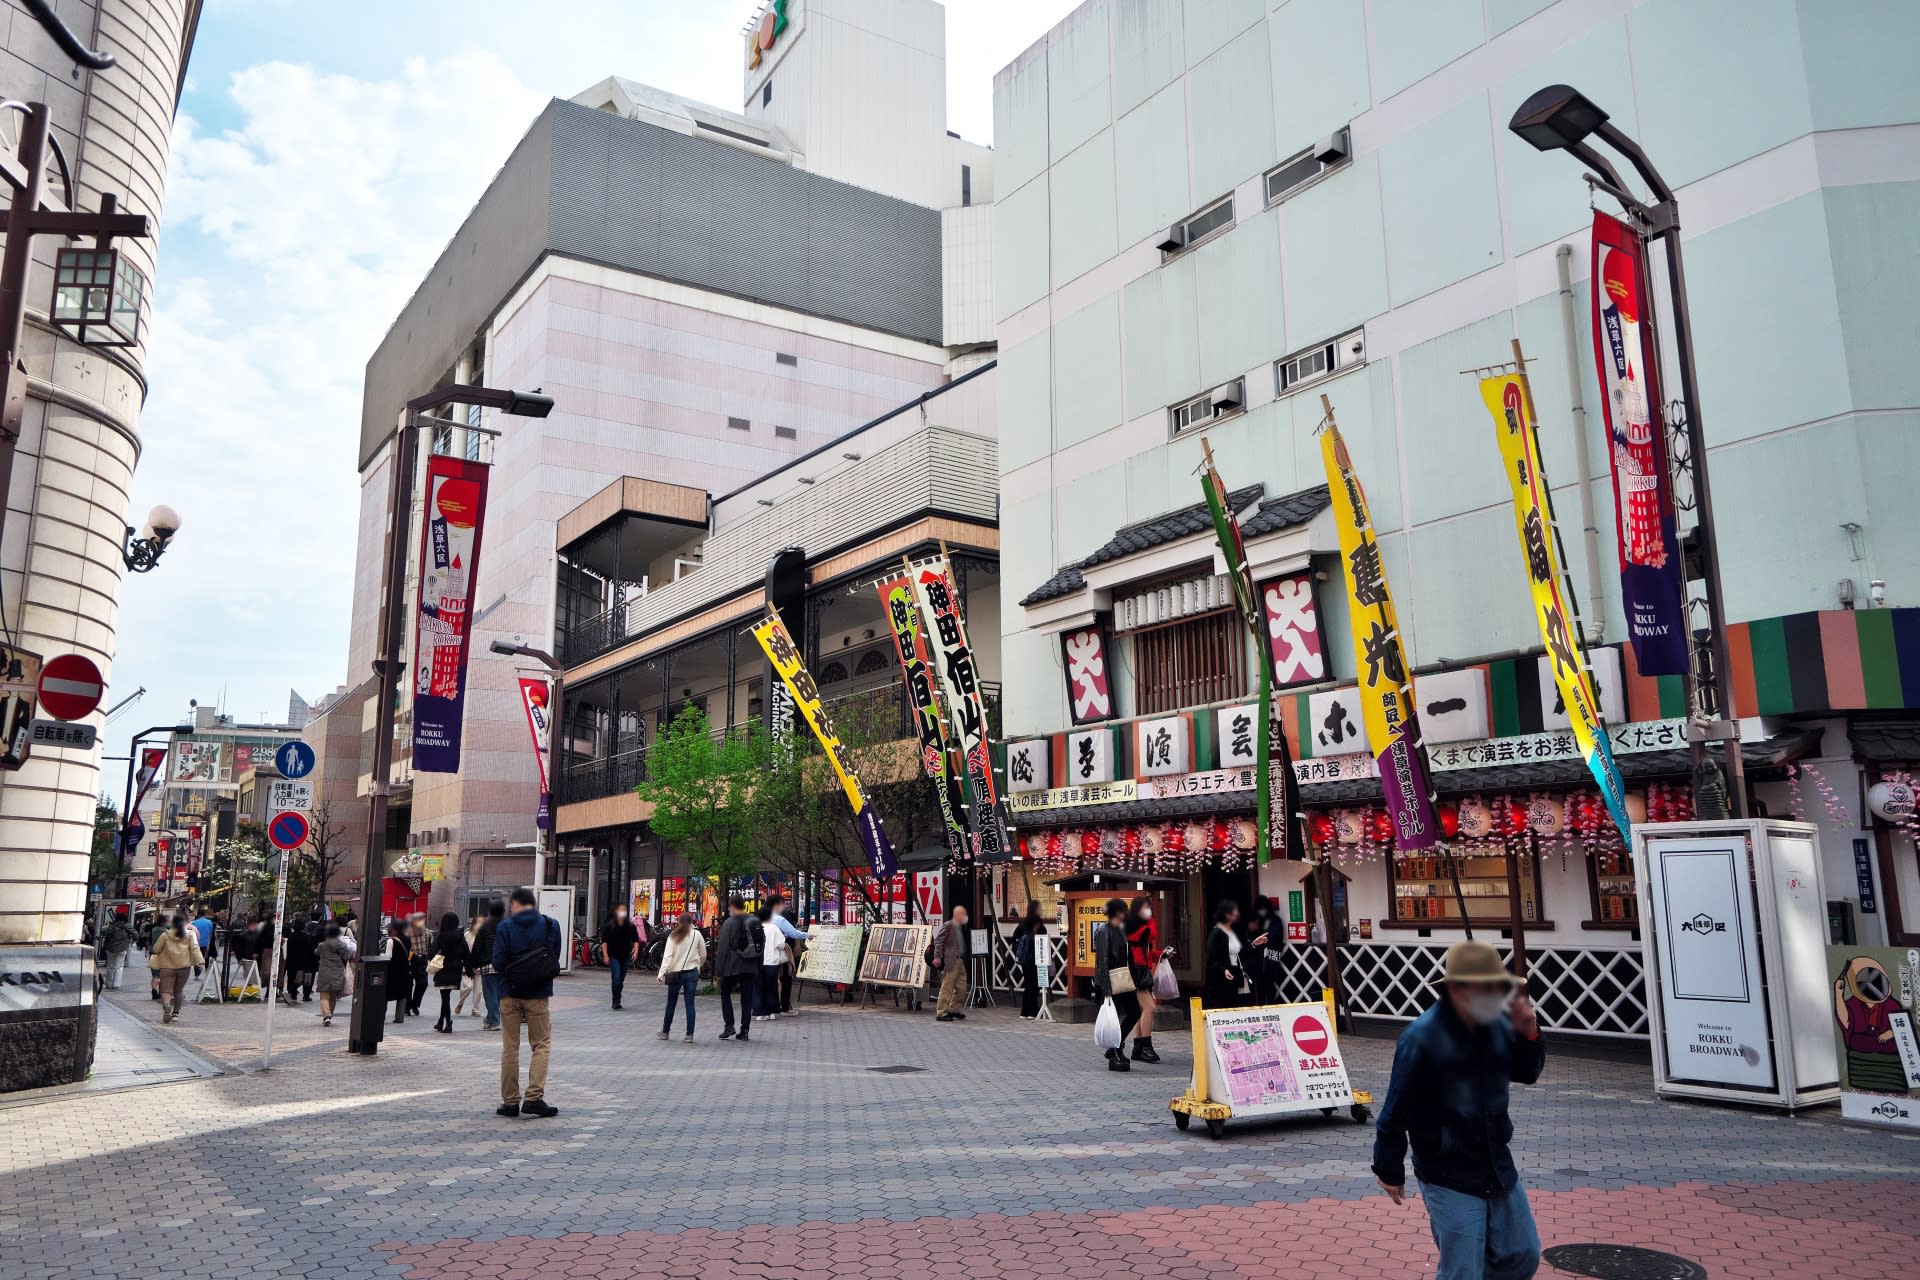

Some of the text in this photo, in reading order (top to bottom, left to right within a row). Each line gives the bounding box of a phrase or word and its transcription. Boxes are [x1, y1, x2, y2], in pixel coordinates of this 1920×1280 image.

[434, 525, 447, 563] 浅草六区
[771, 681, 780, 739] PACHINKO
[34, 725, 91, 745] 自転車を除く
[420, 729, 443, 739] ROKKU
[415, 738, 450, 748] BROADWAY
[1288, 926, 1307, 937] 禁煙
[1697, 1023, 1724, 1031] Welcome
[1698, 1033, 1733, 1045] ROKKU
[1689, 1044, 1745, 1057] BROADWAY
[1298, 1056, 1340, 1071] 進入禁止
